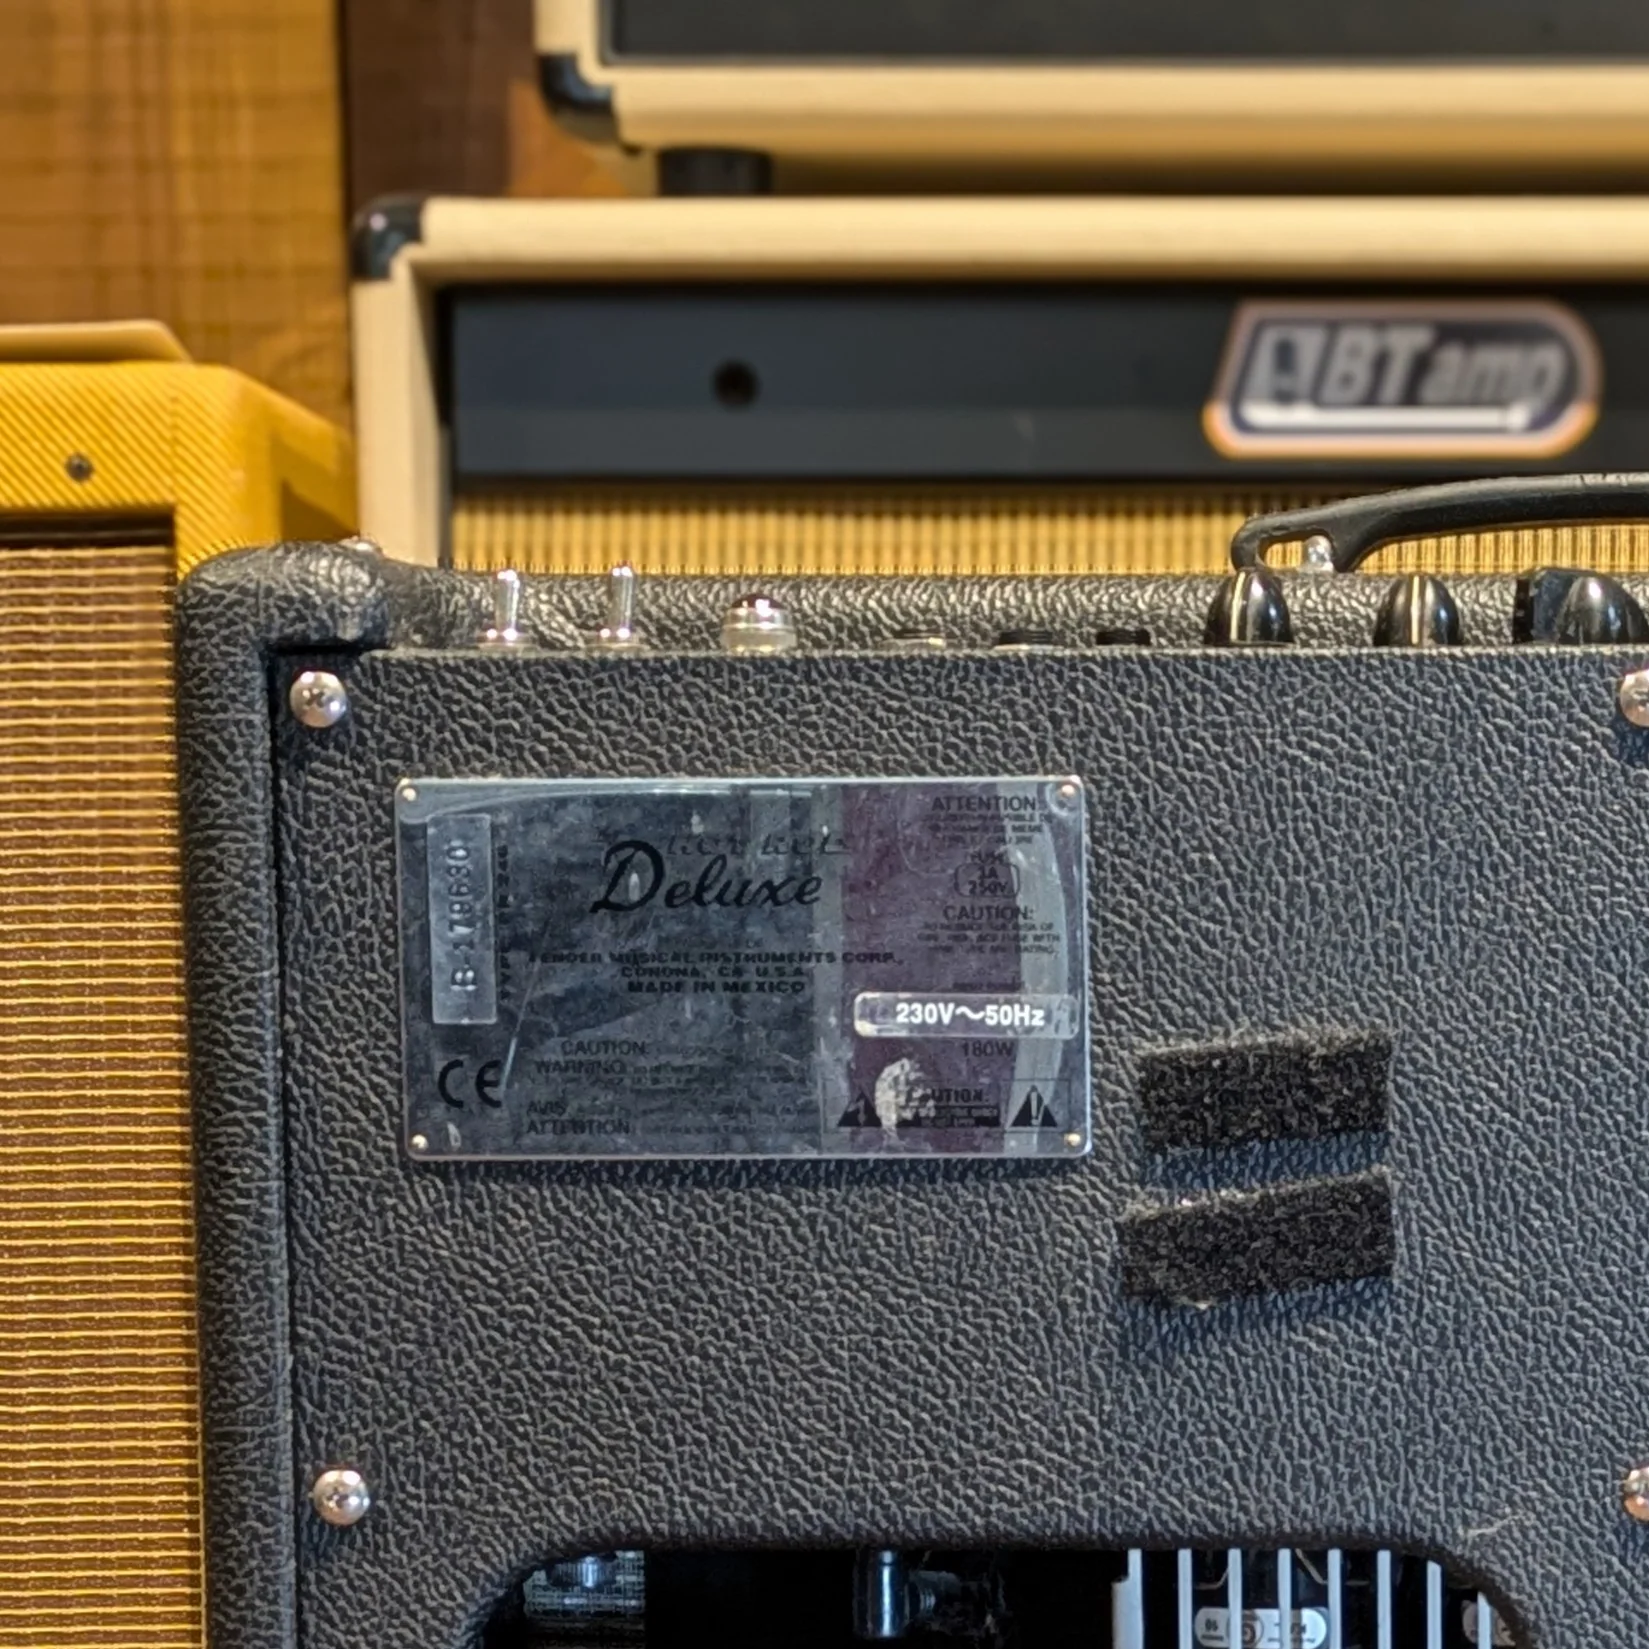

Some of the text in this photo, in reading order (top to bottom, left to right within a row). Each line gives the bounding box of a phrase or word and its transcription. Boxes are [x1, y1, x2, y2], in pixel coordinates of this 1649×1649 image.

[589, 839, 824, 914] Deluxe
[722, 981, 806, 994] MEXICO
[961, 1041, 1015, 1057] 180W
